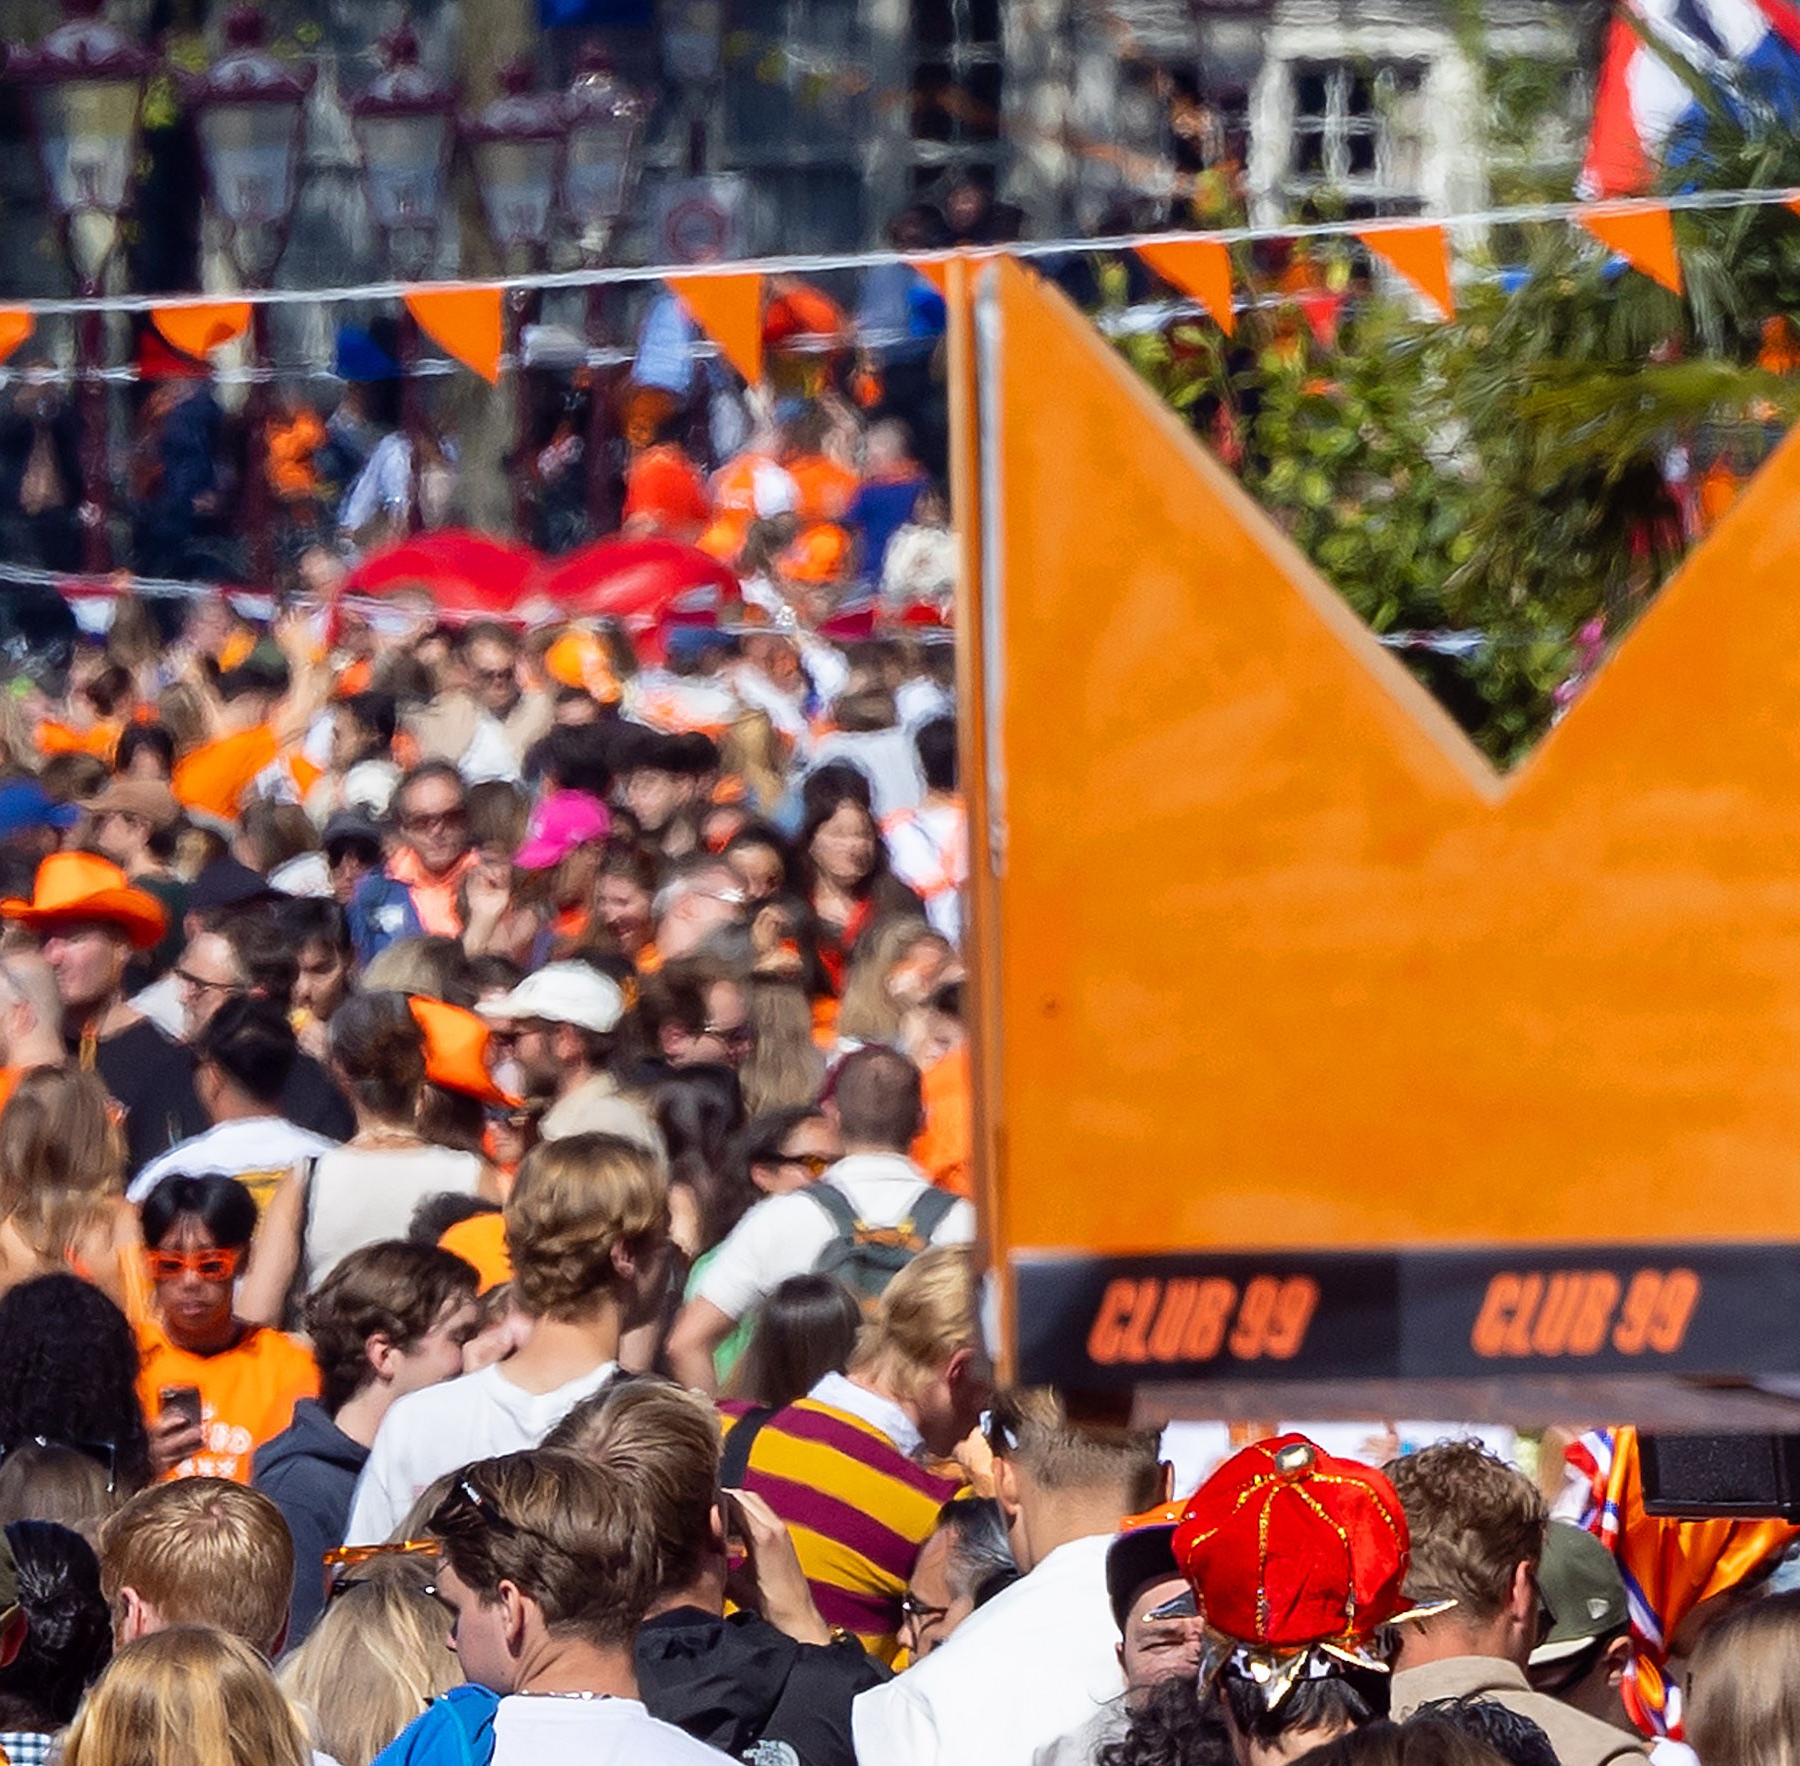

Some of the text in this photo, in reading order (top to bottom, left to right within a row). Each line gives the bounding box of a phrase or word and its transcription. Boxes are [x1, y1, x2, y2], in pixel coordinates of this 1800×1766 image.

[1088, 1277, 1317, 1363] CLUB 99
[1471, 1268, 1700, 1357] CLUB 99
